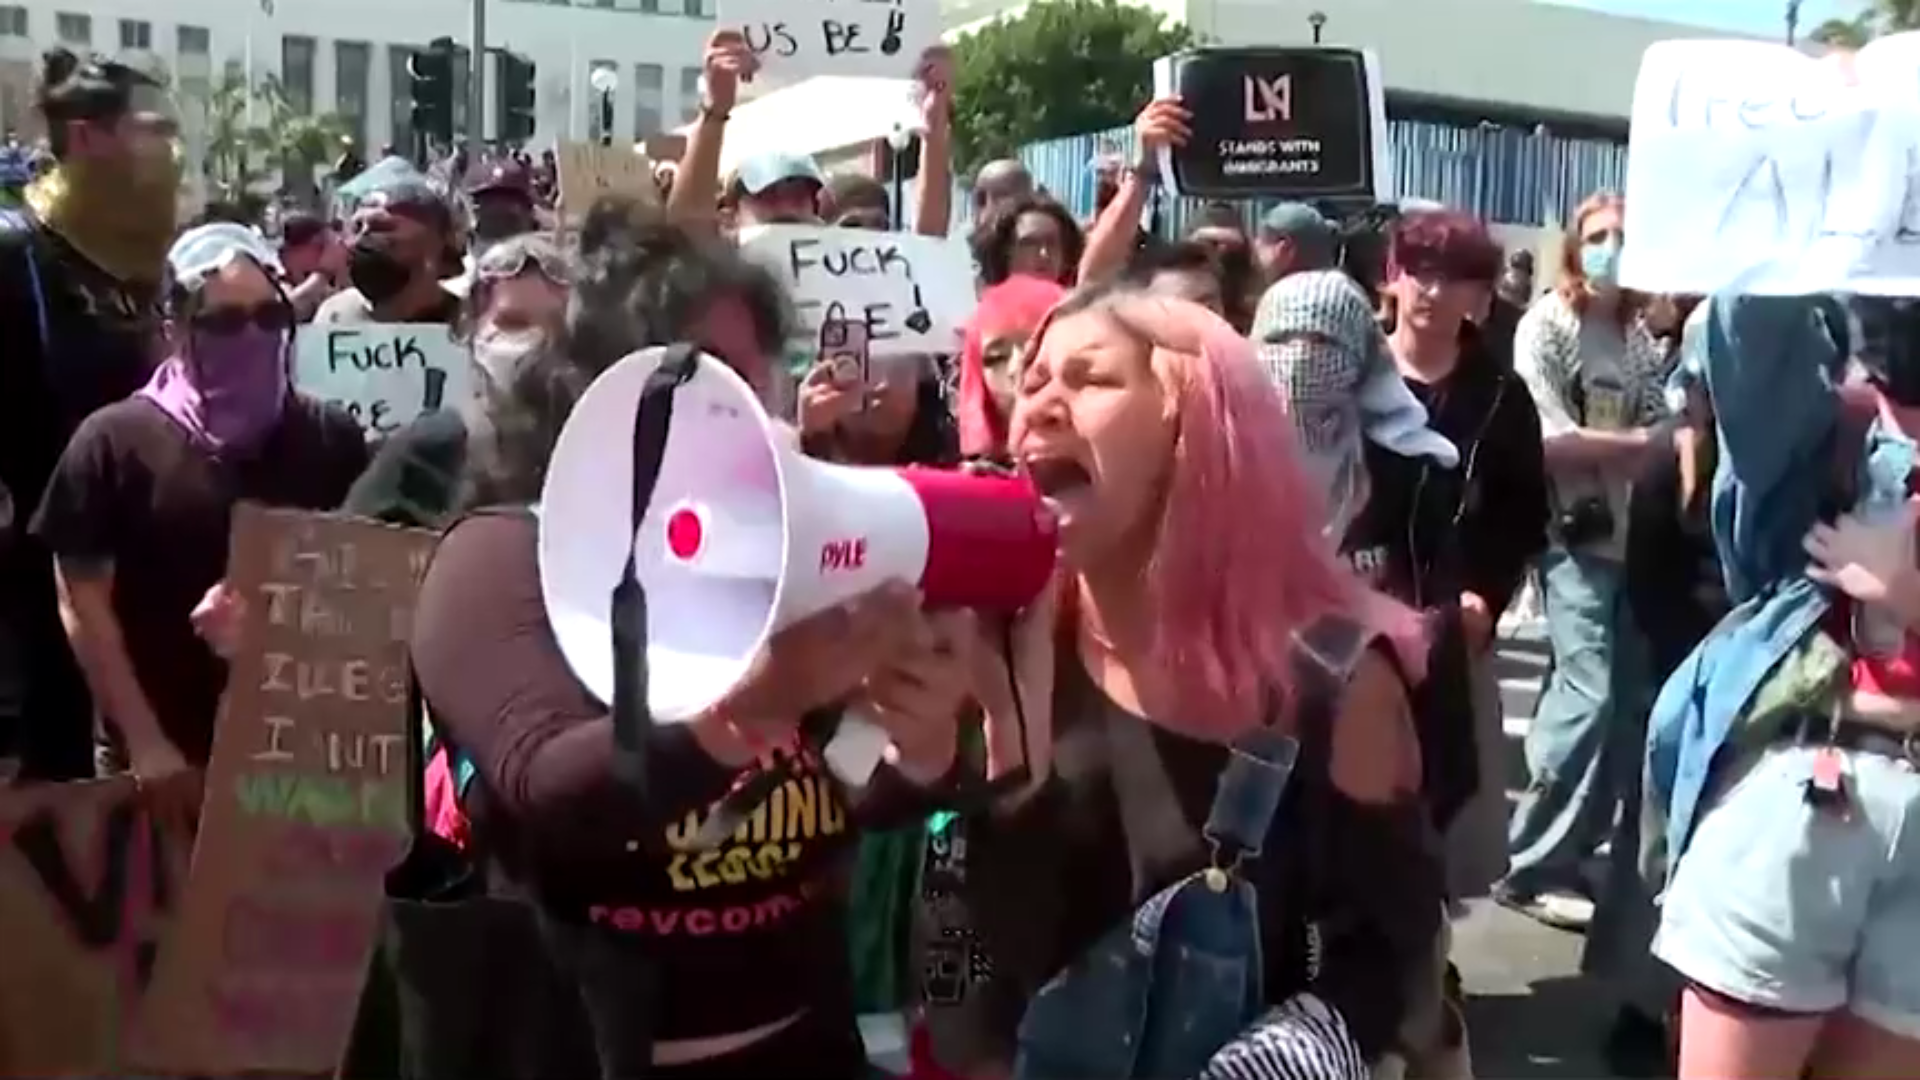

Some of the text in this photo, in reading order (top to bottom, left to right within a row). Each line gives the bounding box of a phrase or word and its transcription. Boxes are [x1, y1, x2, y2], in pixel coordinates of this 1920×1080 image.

[744, 21, 798, 55] US
[1219, 138, 1321, 156] STANDS WITH
[1223, 159, 1320, 175] IMMIGRANTS
[819, 537, 867, 574] PYLE
